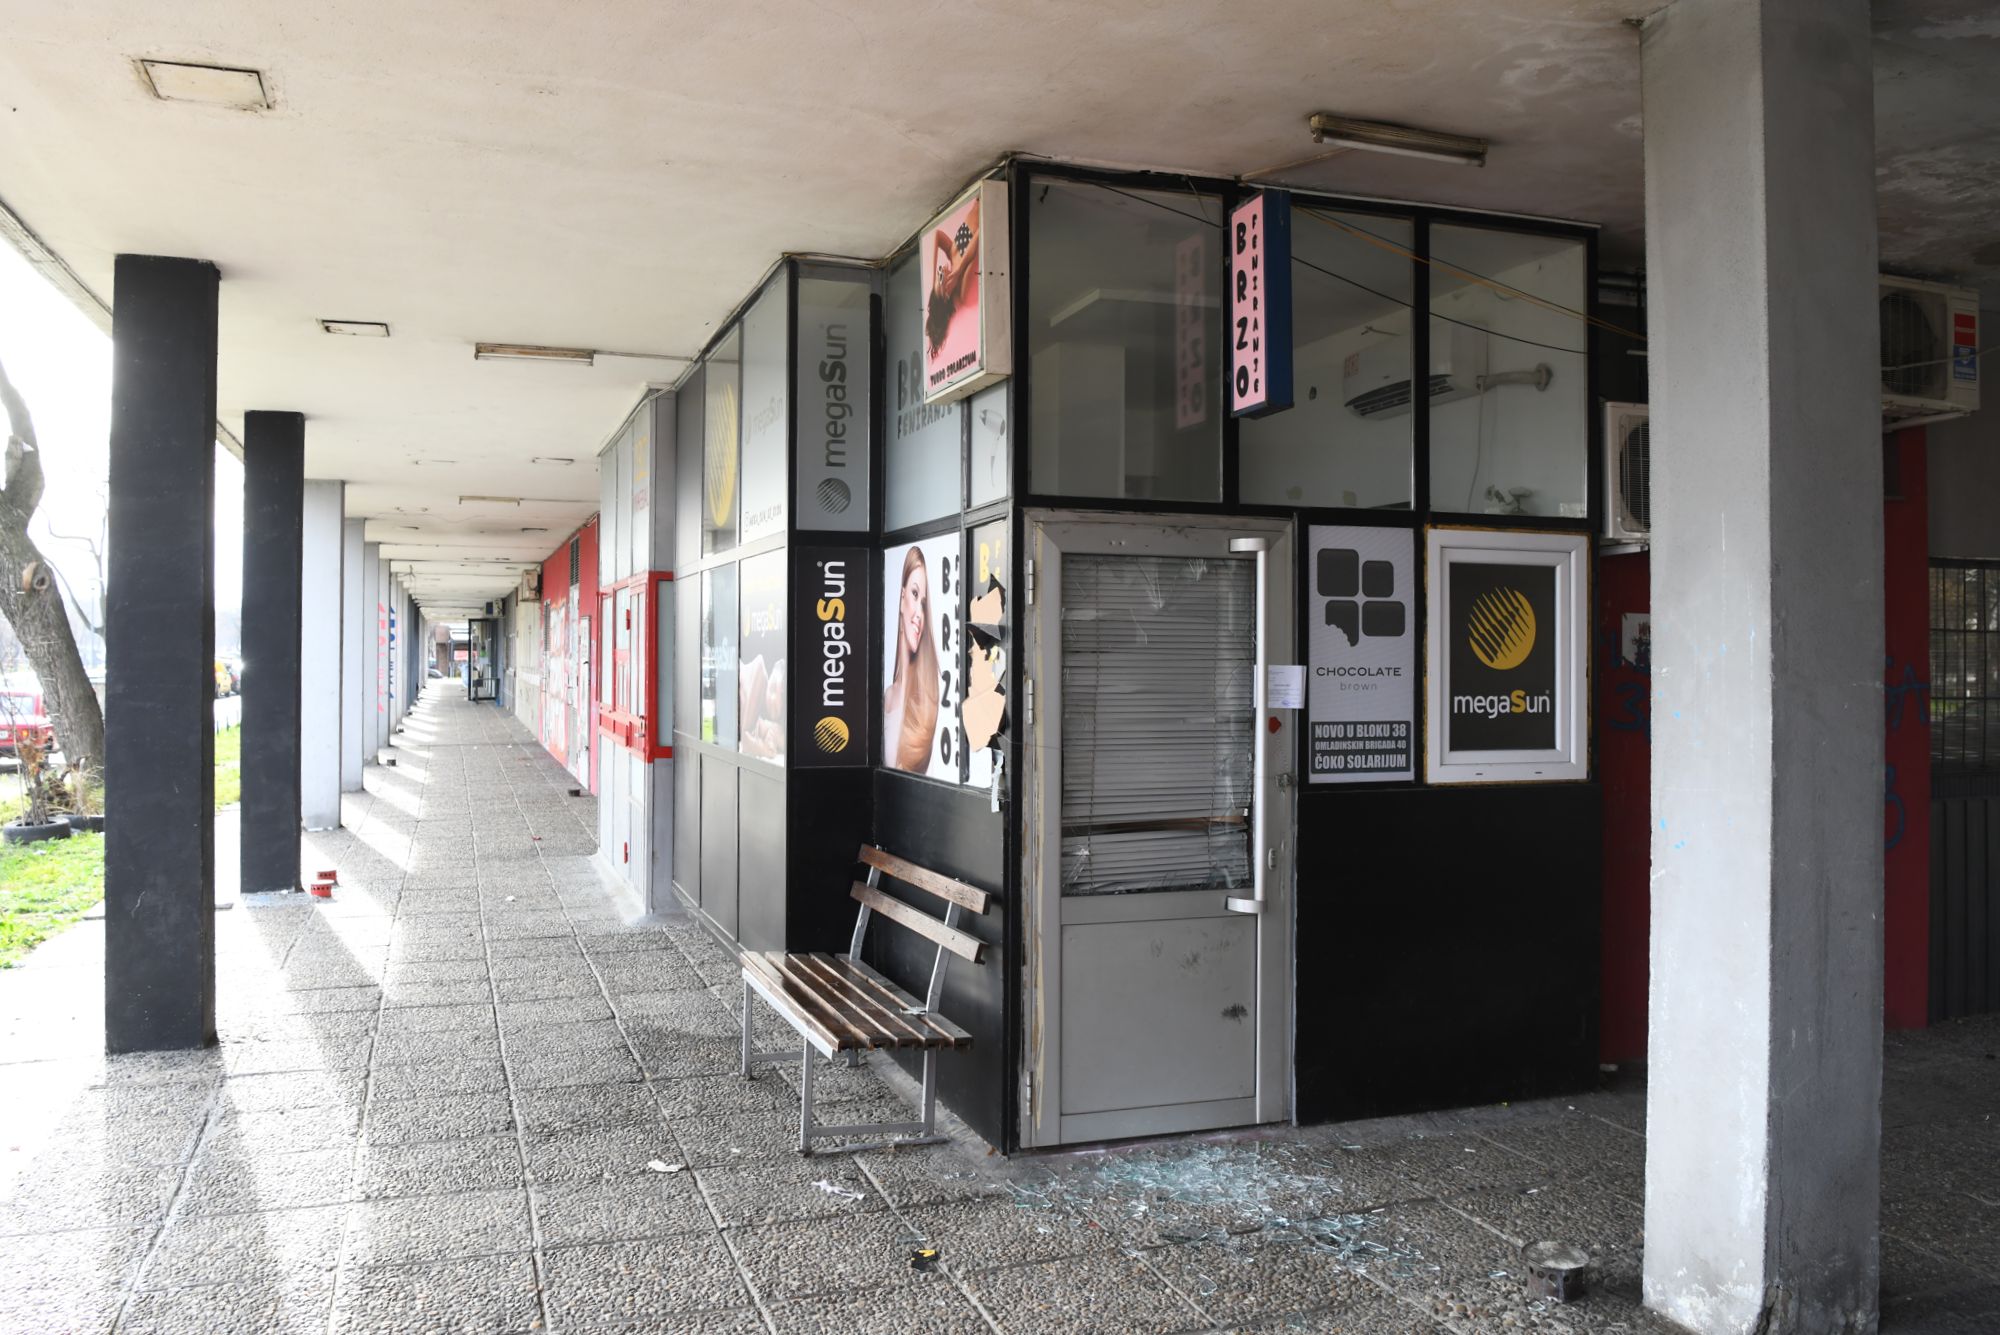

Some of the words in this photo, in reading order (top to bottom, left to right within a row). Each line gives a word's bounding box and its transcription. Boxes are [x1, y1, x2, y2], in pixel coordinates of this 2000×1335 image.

[1236, 222, 1249, 398] BRZO
[818, 322, 853, 467] megaSun
[816, 561, 851, 706] megaSun
[941, 556, 951, 766] BRZO
[1316, 667, 1402, 677] CHOCOLATE
[1340, 682, 1378, 692] brown
[1453, 689, 1550, 719] megaSun
[1315, 724, 1344, 738] NOVO
[1346, 724, 1354, 738] U
[1356, 724, 1390, 738] BLOKU
[1392, 723, 1406, 737] 38
[1315, 740, 1363, 750] OMLADINSKIH
[1365, 740, 1395, 750] BRIGADA
[1315, 753, 1345, 769] ČOKO
[1347, 754, 1406, 769] SOLARIJUM
